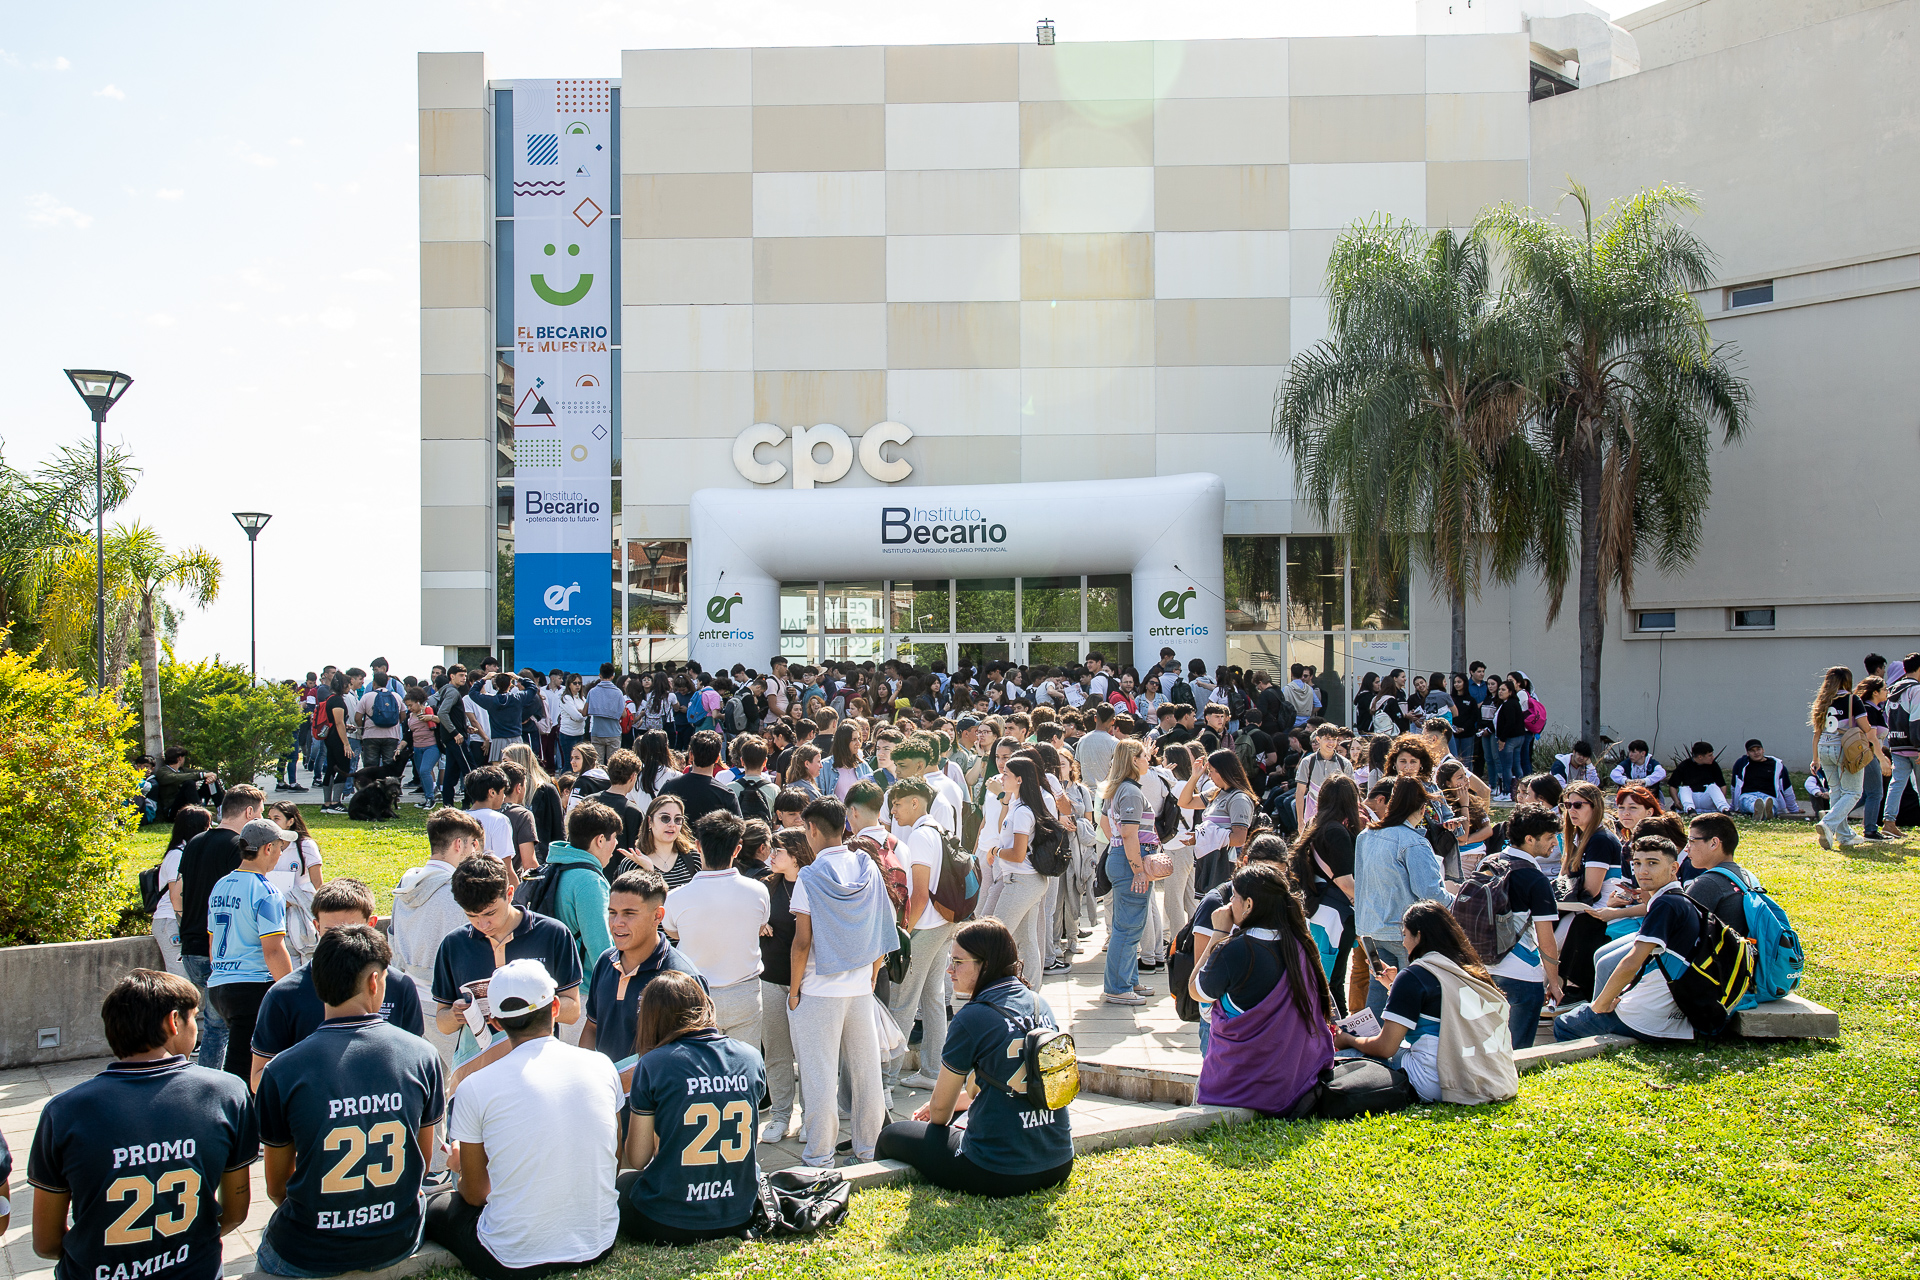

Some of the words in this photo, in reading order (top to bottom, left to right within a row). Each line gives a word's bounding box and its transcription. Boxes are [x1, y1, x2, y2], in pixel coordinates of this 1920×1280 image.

[518, 326, 534, 339] EL
[536, 325, 608, 339] BECARIO
[518, 341, 535, 353] TE
[537, 341, 608, 353] MUESTRA
[732, 421, 914, 490] cpc
[525, 490, 600, 515] Becario
[543, 490, 583, 501] Instituto
[881, 507, 1008, 545] Becario
[913, 506, 982, 522] Instituto
[533, 614, 592, 626] entreríos
[1149, 623, 1209, 637] entreríos
[698, 628, 755, 640] entreríos
[214, 912, 233, 960] 7
[686, 1074, 749, 1096] PROMO
[328, 1092, 403, 1119] PROMO
[1018, 1109, 1056, 1129] YANI
[681, 1099, 753, 1167] 23
[112, 1138, 196, 1169] PROMO
[320, 1119, 407, 1194] 23
[686, 1178, 735, 1202] MICA
[104, 1167, 202, 1246] 23
[316, 1200, 396, 1229] ELISEO
[95, 1243, 190, 1280] CAMILO
